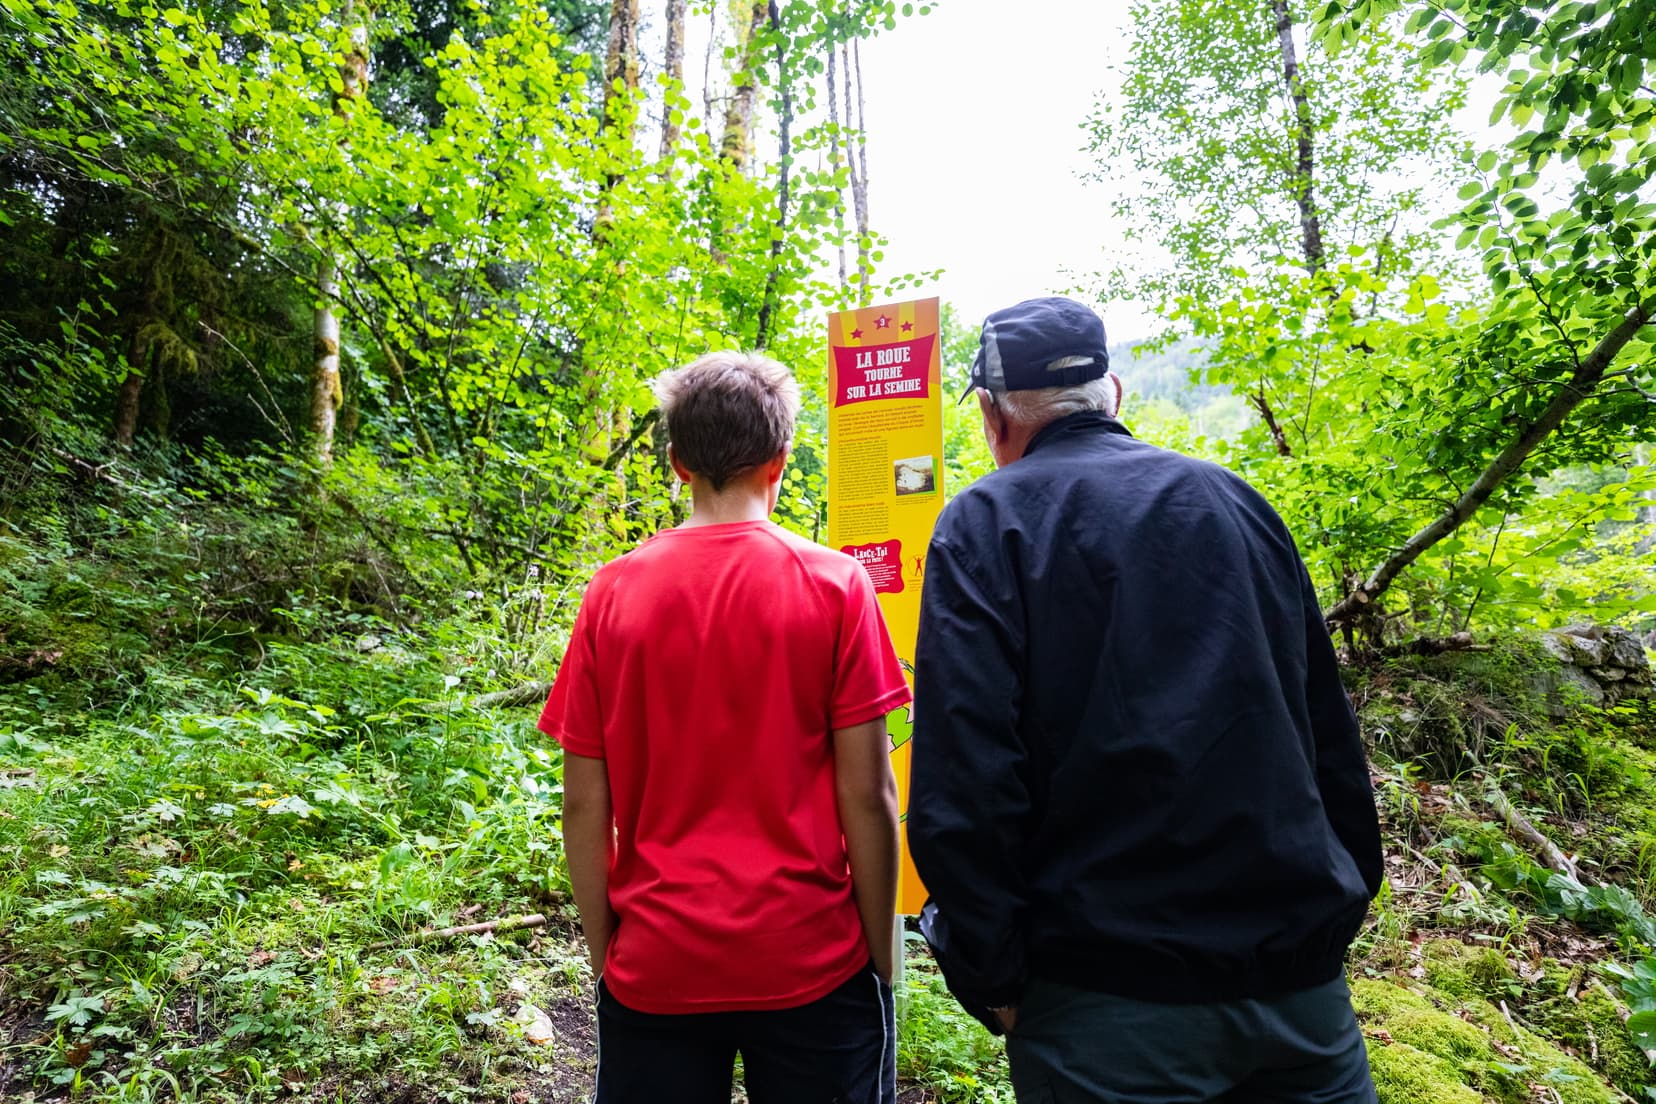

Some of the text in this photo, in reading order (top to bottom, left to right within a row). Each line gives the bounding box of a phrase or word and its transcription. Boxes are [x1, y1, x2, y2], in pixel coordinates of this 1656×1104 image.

[879, 317, 886, 326] 3
[856, 346, 911, 369] LA ROUE
[864, 366, 903, 382] TOURNE
[847, 378, 921, 400] SUR LA SEMINE
